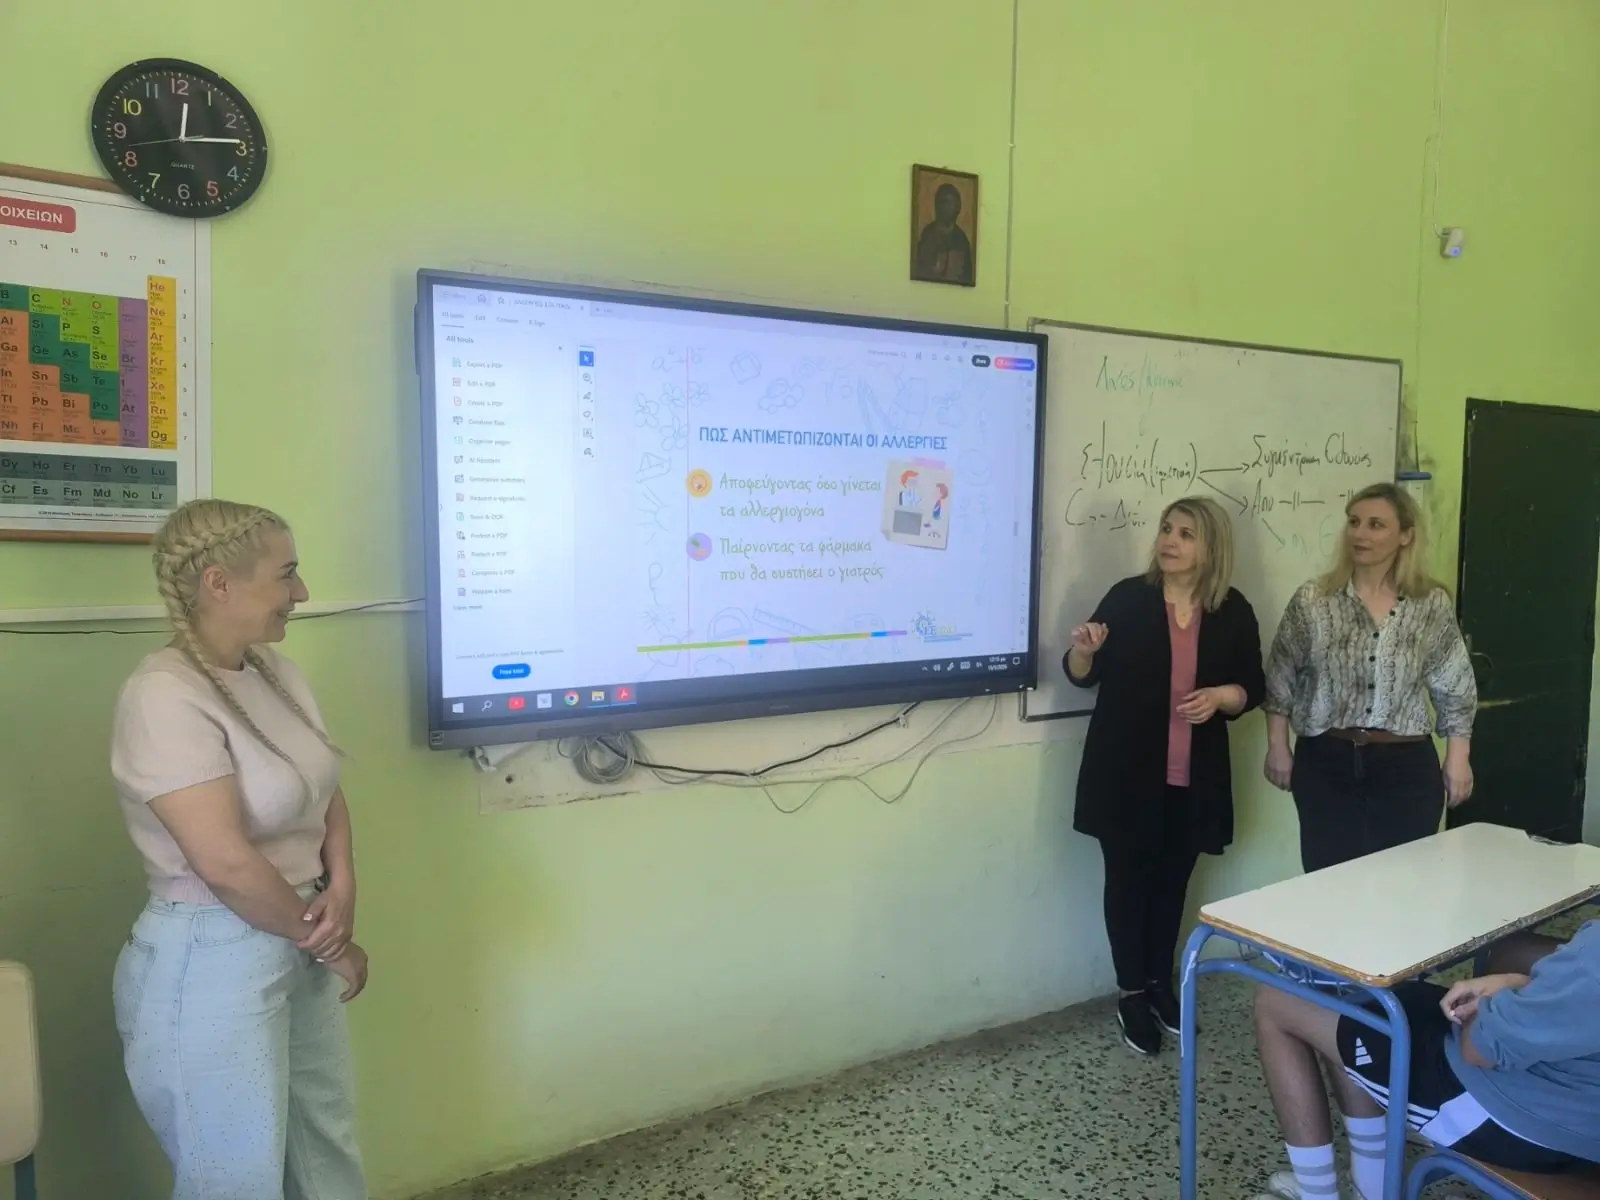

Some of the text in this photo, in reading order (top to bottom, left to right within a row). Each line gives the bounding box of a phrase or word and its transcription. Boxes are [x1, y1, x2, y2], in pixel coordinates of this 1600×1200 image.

[145, 82, 158, 98] 11
[171, 78, 189, 96] 12
[123, 98, 142, 115] 10
[207, 91, 211, 106] 1
[225, 113, 237, 128] 2
[113, 122, 127, 138] 9
[235, 140, 247, 156] 3
[124, 151, 138, 167] 8
[148, 172, 161, 188] 7
[227, 166, 240, 181] 4
[177, 184, 190, 200] 6
[206, 181, 219, 196] 5
[149, 282, 166, 292] He
[31, 293, 41, 303] C
[62, 297, 71, 306] N
[91, 300, 102, 310] O
[149, 307, 166, 317] Ne
[1, 315, 13, 325] Al
[31, 319, 44, 329] Si
[62, 322, 71, 331] P
[92, 325, 101, 335] S
[149, 331, 164, 341] Ar
[446, 335, 456, 343] All
[0, 342, 18, 352] Ga
[63, 348, 79, 358] As
[92, 350, 108, 361] Se
[150, 356, 165, 366] Kr
[1, 368, 13, 378] In
[31, 370, 49, 381] Sn
[63, 373, 79, 383] Sb
[150, 381, 166, 391] Xe
[1, 394, 13, 404] Tl
[32, 396, 49, 406] Pb
[62, 398, 75, 408] Bi
[121, 403, 136, 413] At
[150, 405, 167, 415] Rn
[1, 420, 19, 430] Nh
[151, 430, 168, 442] Og
[699, 426, 948, 450] ΠΩΣ ΑΝΤΙΜΕΤΩΠΙΖΟΝΤΑΙ ΟΙ ΑΛΛΕΡΓΙΕΣ
[2, 458, 166, 476] Dy Ho Er Tm Yb Lu
[2, 484, 164, 500] Cf Es Fm Md No Lr
[719, 472, 882, 495] Αποφεύγοντας όσο γίνεται
[720, 500, 825, 522] τα αλλεργιογόνα
[719, 537, 873, 560] Παίρνοντας τα φάρμακα
[720, 561, 884, 583] που θα συστήσει ο γιατρός
